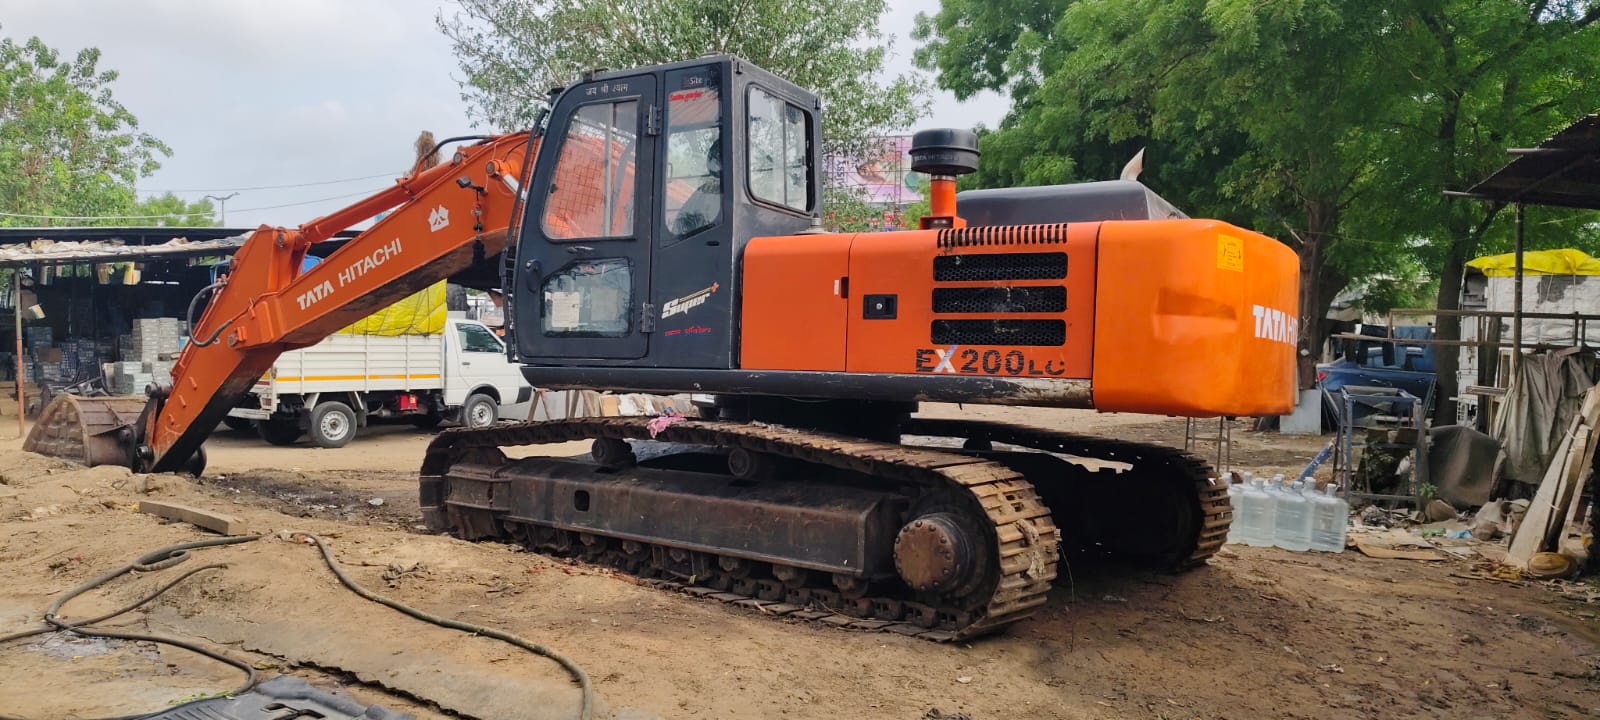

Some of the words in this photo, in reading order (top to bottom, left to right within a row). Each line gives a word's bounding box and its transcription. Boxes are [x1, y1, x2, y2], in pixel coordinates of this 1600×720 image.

[297, 280, 334, 311] TATA
[338, 237, 402, 287] HITACHI
[1252, 304, 1287, 344] TATA
